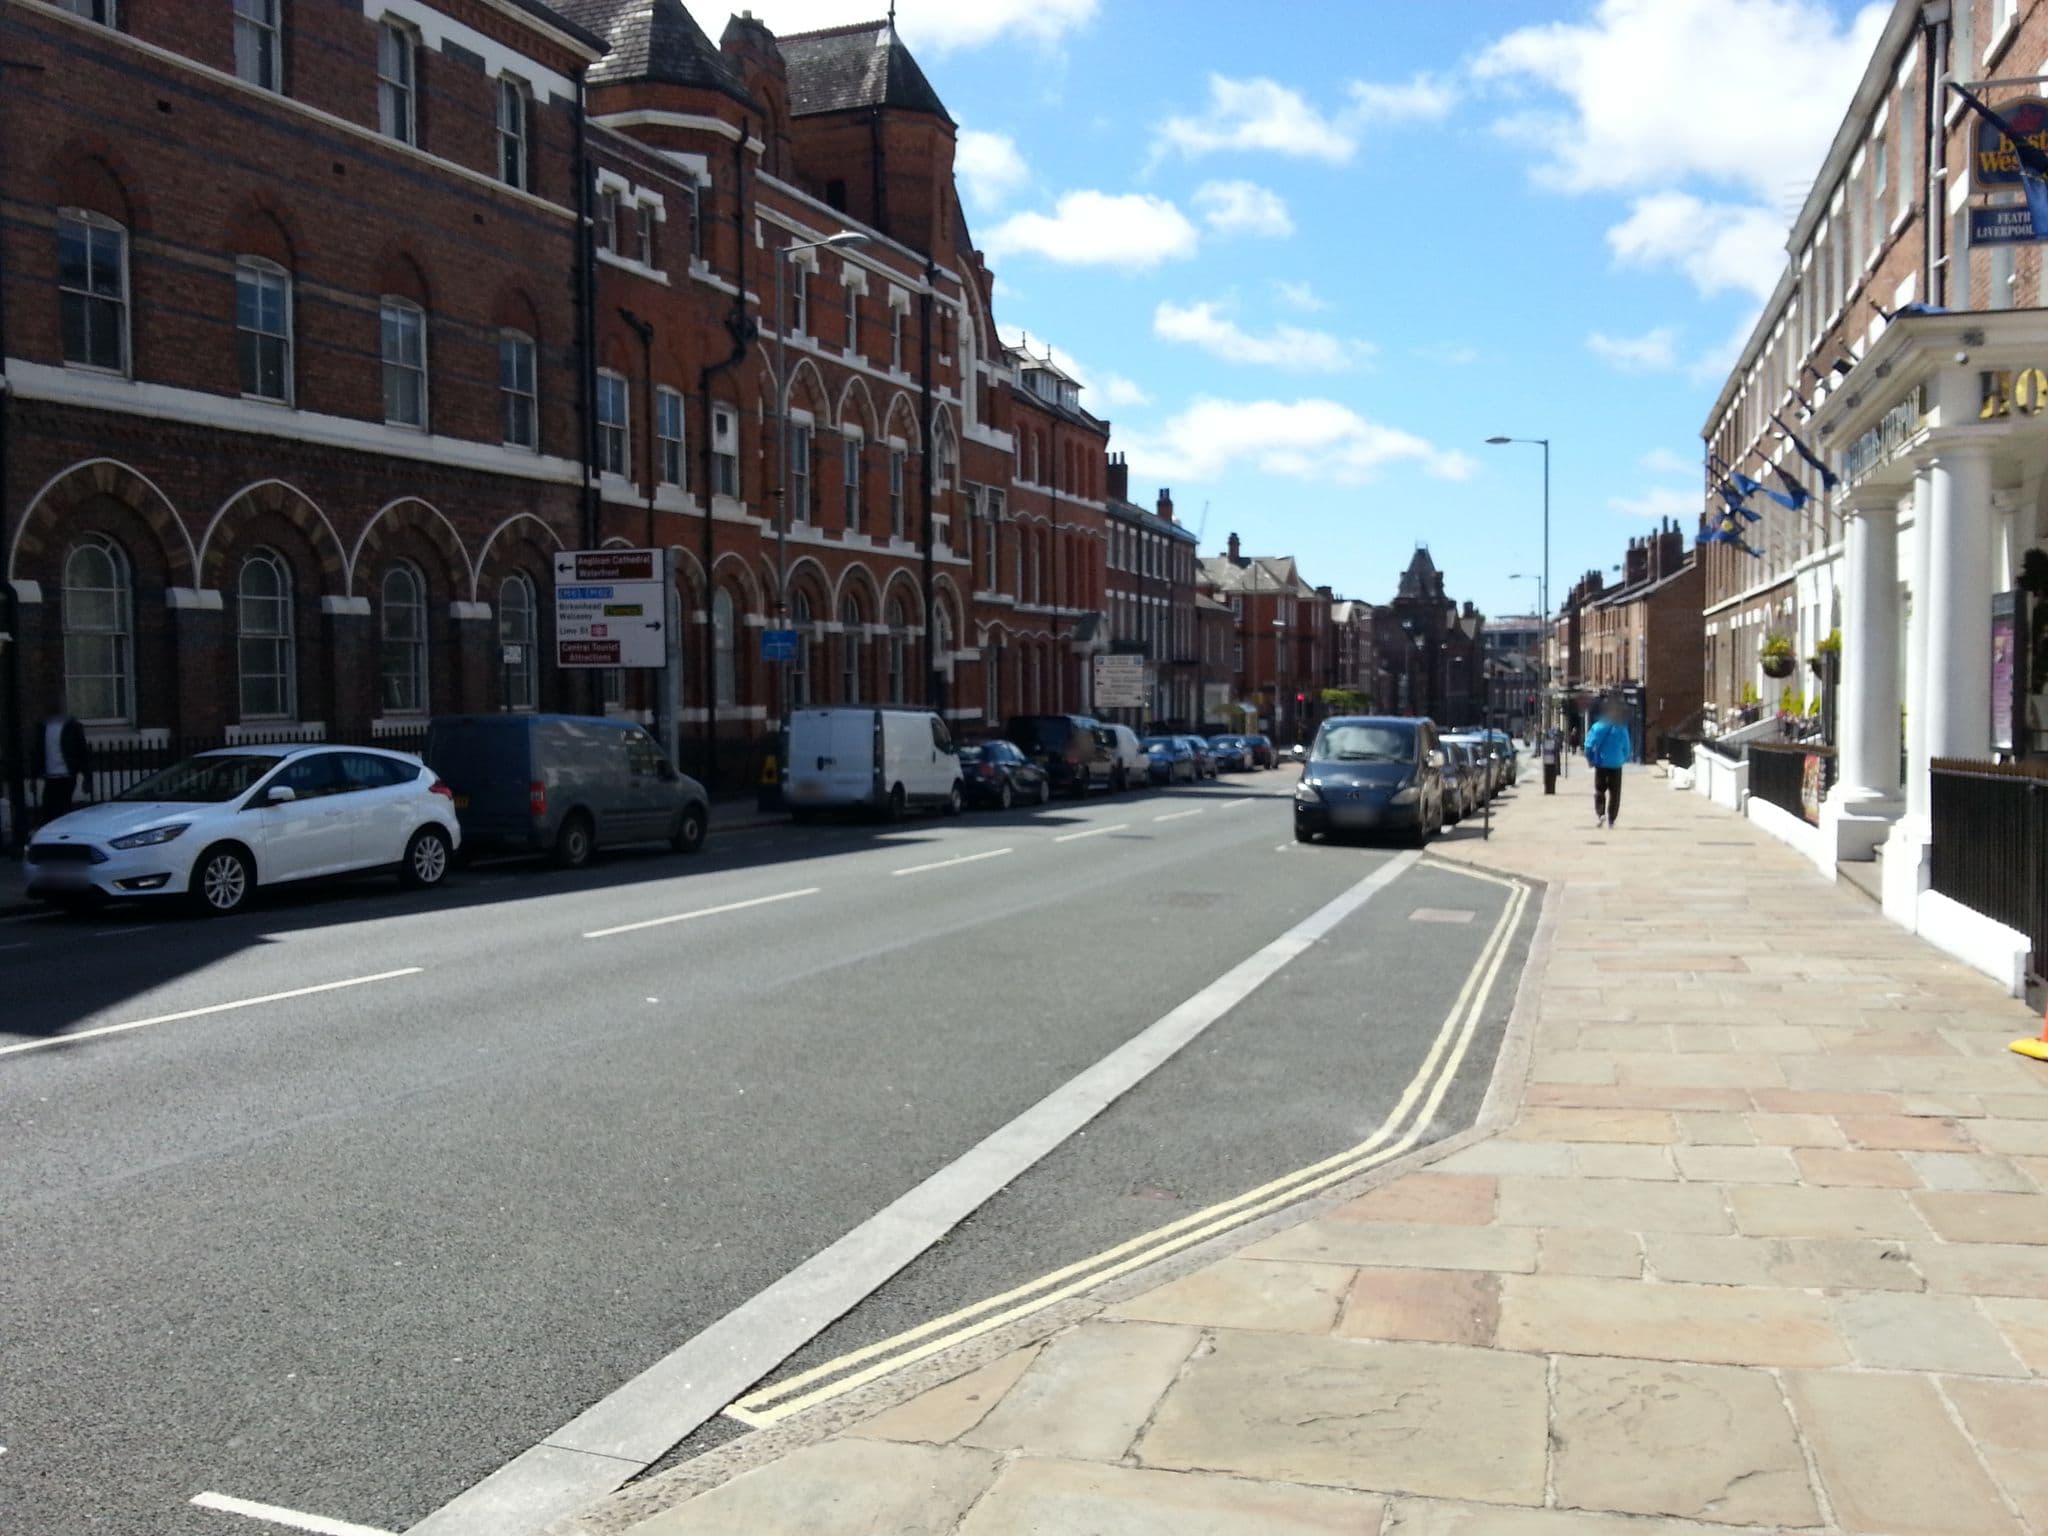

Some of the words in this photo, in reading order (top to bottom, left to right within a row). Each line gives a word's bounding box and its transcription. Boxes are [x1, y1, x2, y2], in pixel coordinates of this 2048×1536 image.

[2000, 129, 2048, 152] Bst
[1977, 224, 2034, 239] LIVERPOOL
[577, 556, 611, 567] Anglican
[612, 554, 650, 565] Cathedral
[578, 568, 620, 577] Waterfront
[559, 602, 602, 610] Birkenhead
[559, 613, 592, 622] Wallasey
[559, 626, 577, 635] Lime
[580, 626, 589, 635] St
[561, 642, 591, 652] Central
[592, 641, 618, 651] Tourist
[568, 653, 612, 662] Attractions
